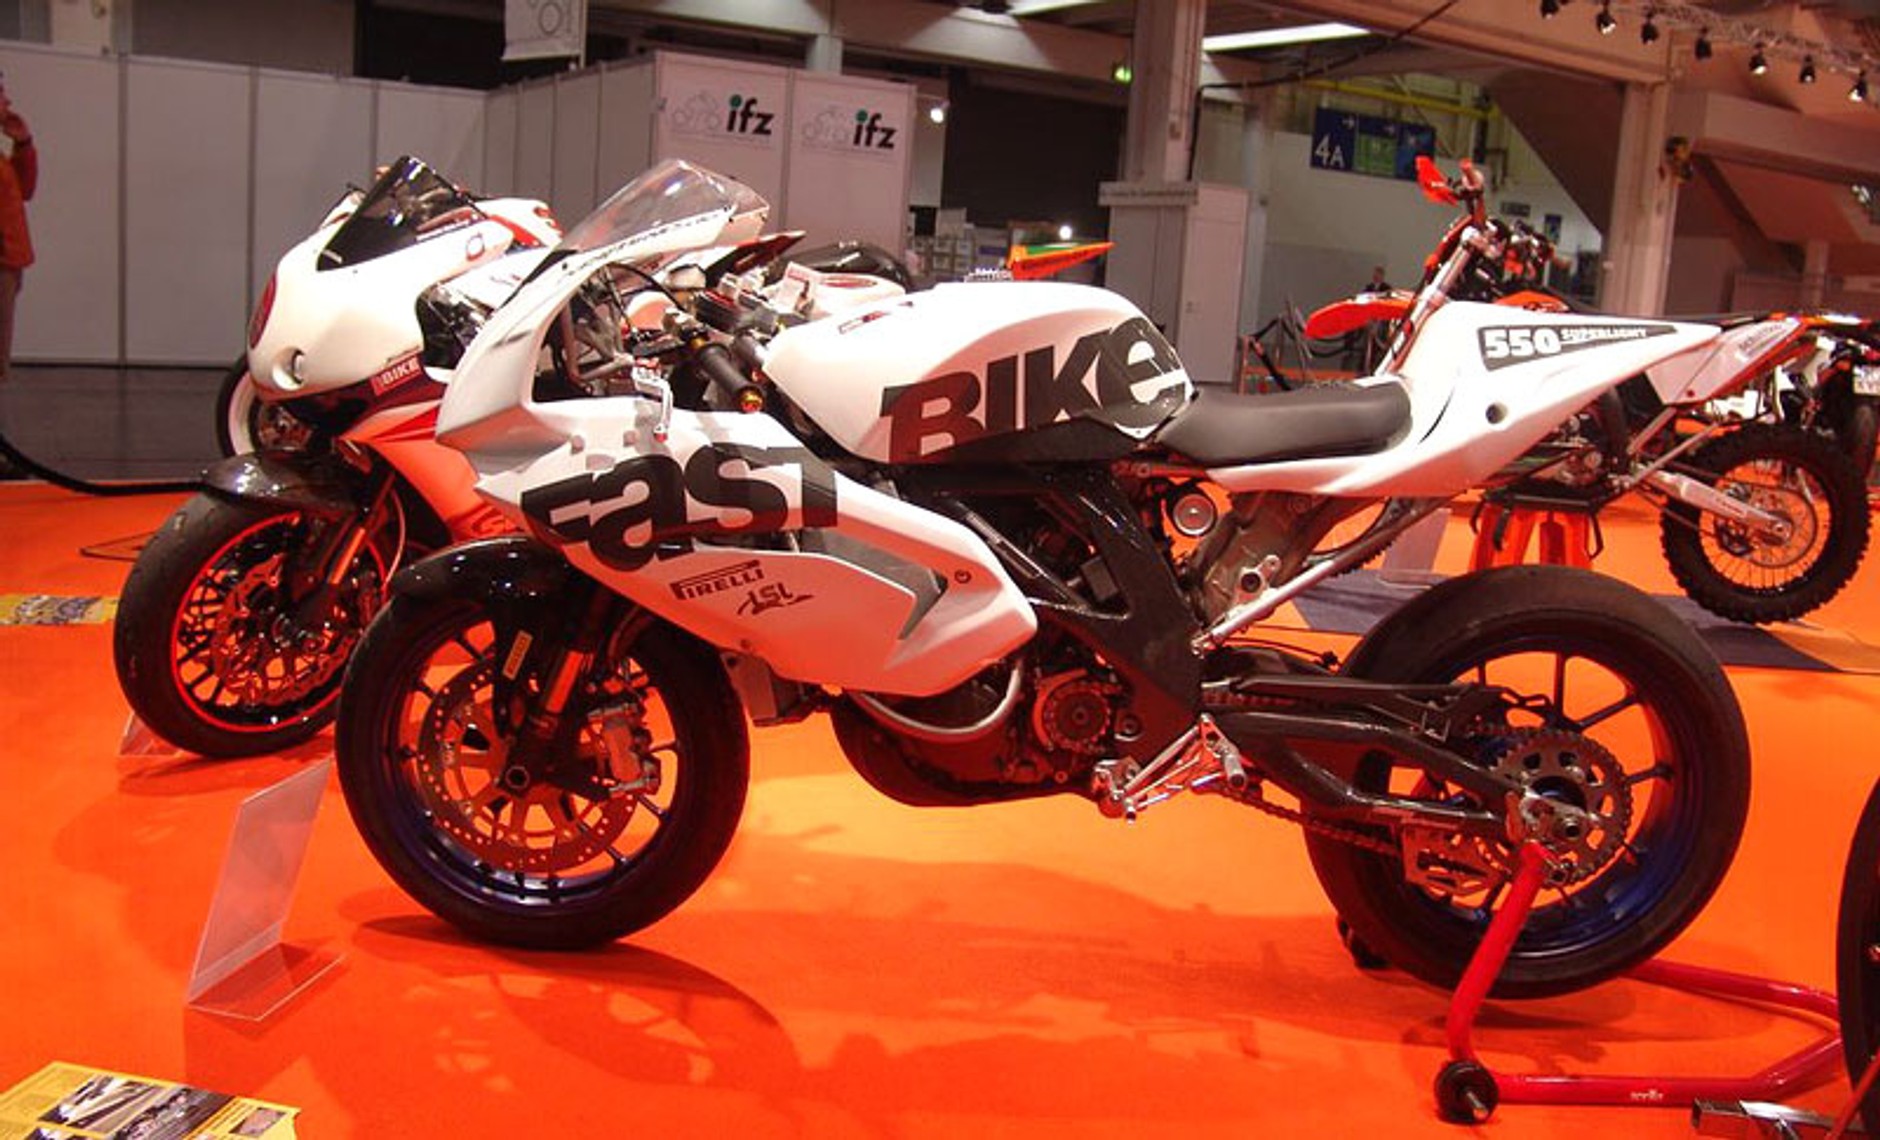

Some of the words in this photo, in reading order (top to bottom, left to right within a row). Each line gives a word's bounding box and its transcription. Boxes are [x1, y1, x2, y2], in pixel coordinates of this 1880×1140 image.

[726, 94, 774, 135] ifz
[853, 109, 897, 149] ifz
[1315, 132, 1345, 168] 4A
[1484, 327, 1562, 358] 550
[669, 559, 765, 600] PIRELLI
